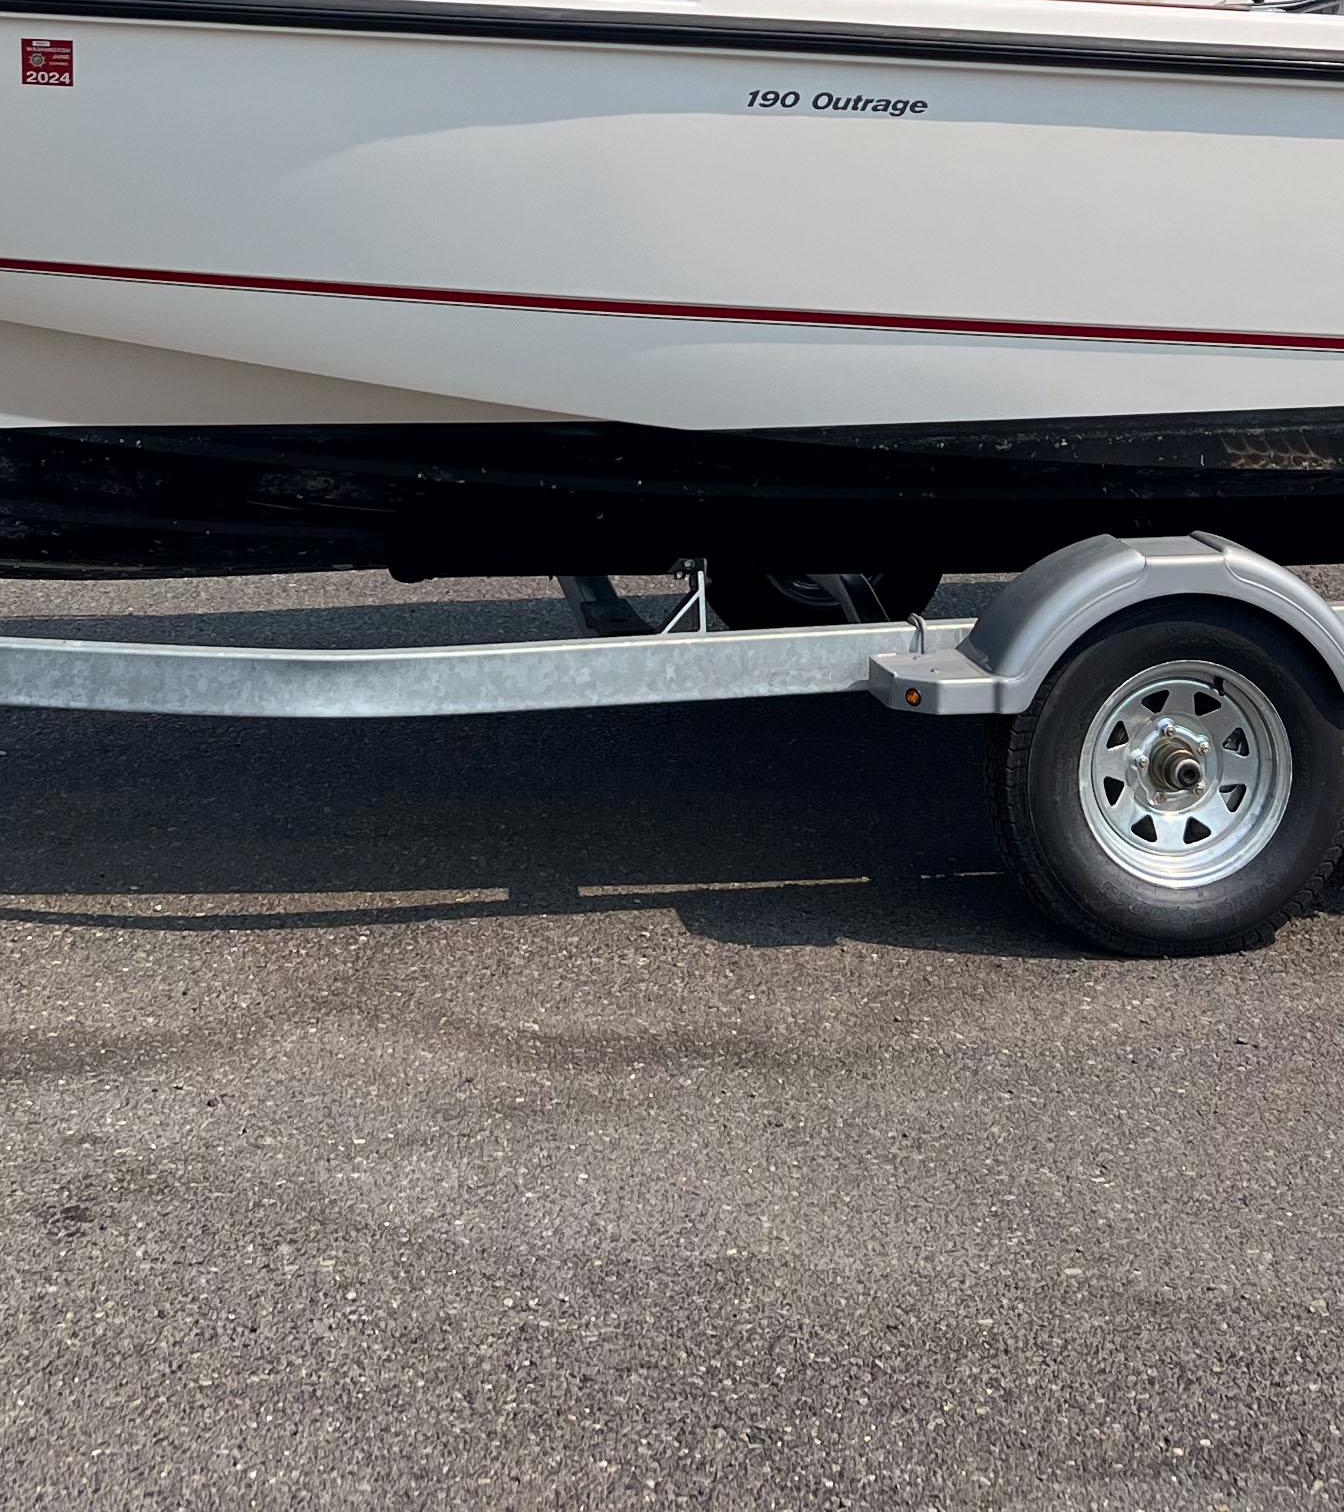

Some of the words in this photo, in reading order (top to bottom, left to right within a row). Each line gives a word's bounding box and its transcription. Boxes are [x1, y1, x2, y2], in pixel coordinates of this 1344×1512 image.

[26, 71, 71, 85] 2024
[747, 90, 801, 109] 190
[811, 92, 929, 117] Outrage
